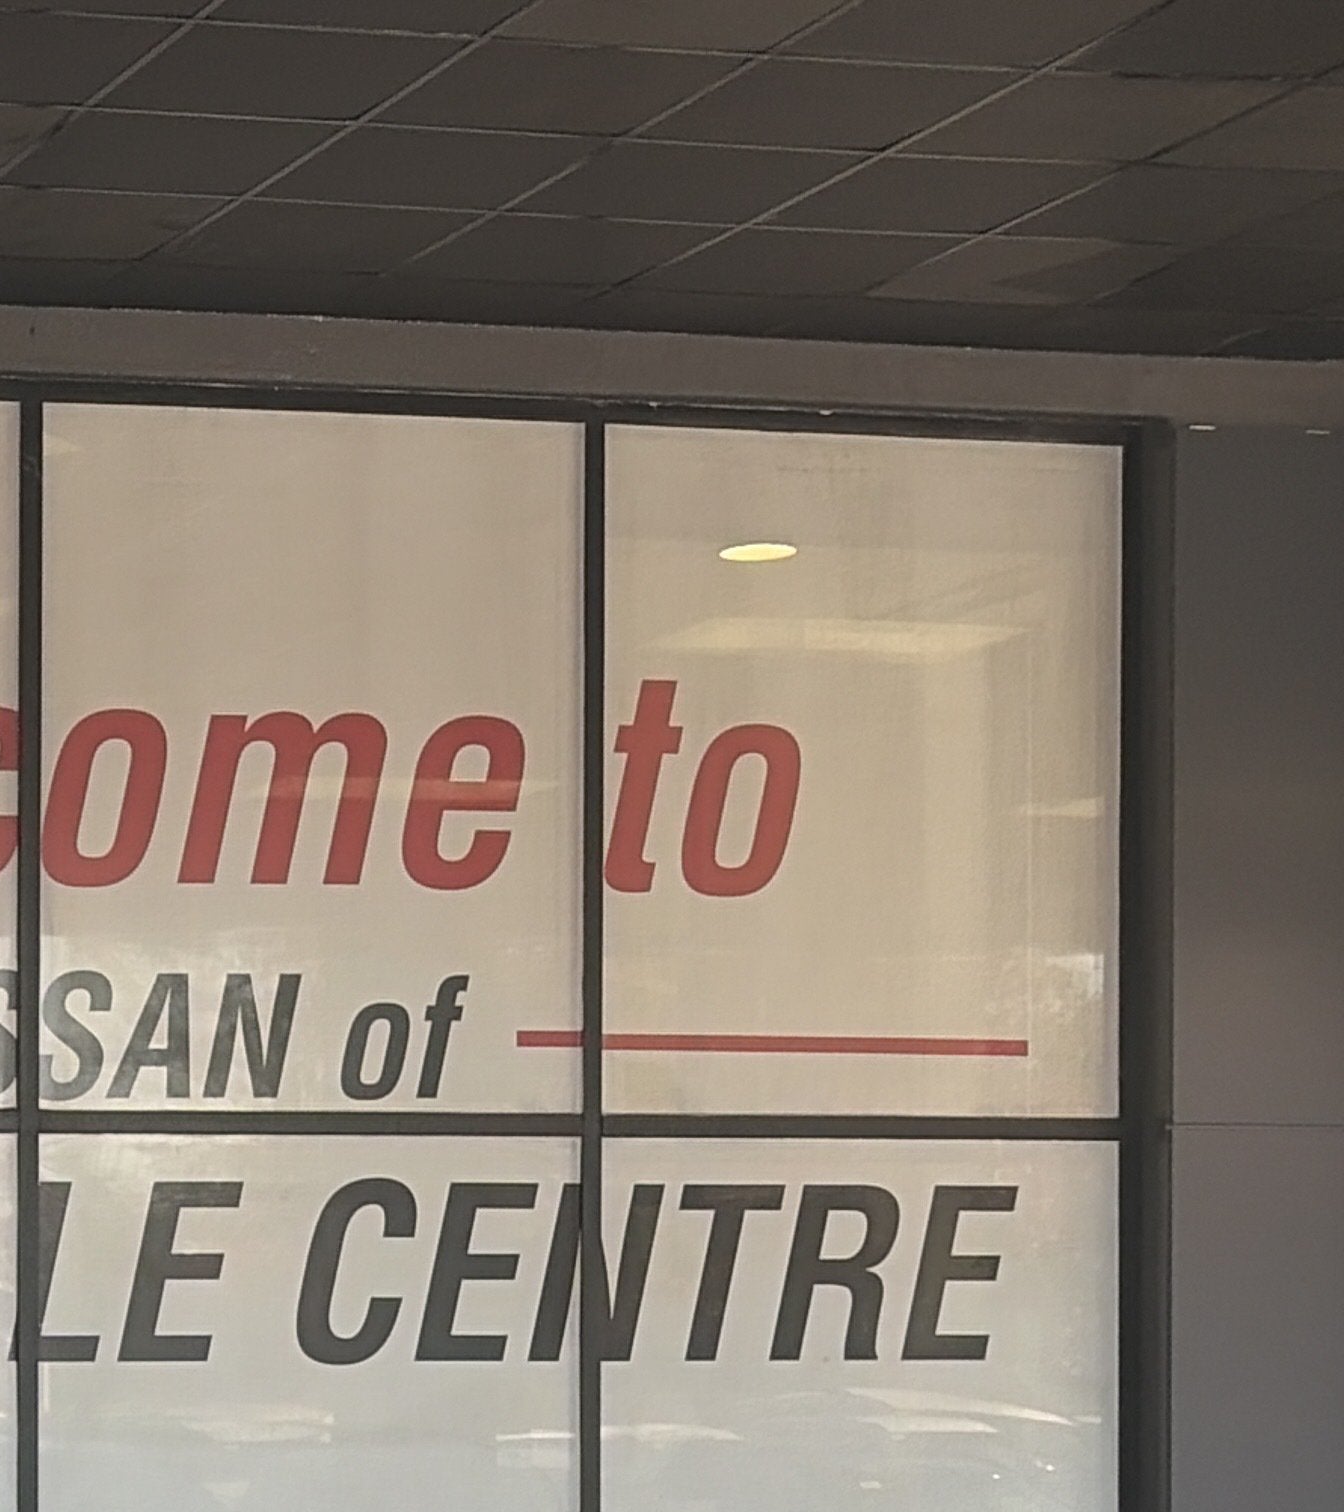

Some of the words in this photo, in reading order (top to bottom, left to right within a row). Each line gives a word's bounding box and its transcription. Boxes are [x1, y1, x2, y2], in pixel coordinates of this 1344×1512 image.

[605, 678, 805, 898] to
[339, 975, 469, 1101] of
[294, 1179, 1020, 1364] CENTRE
